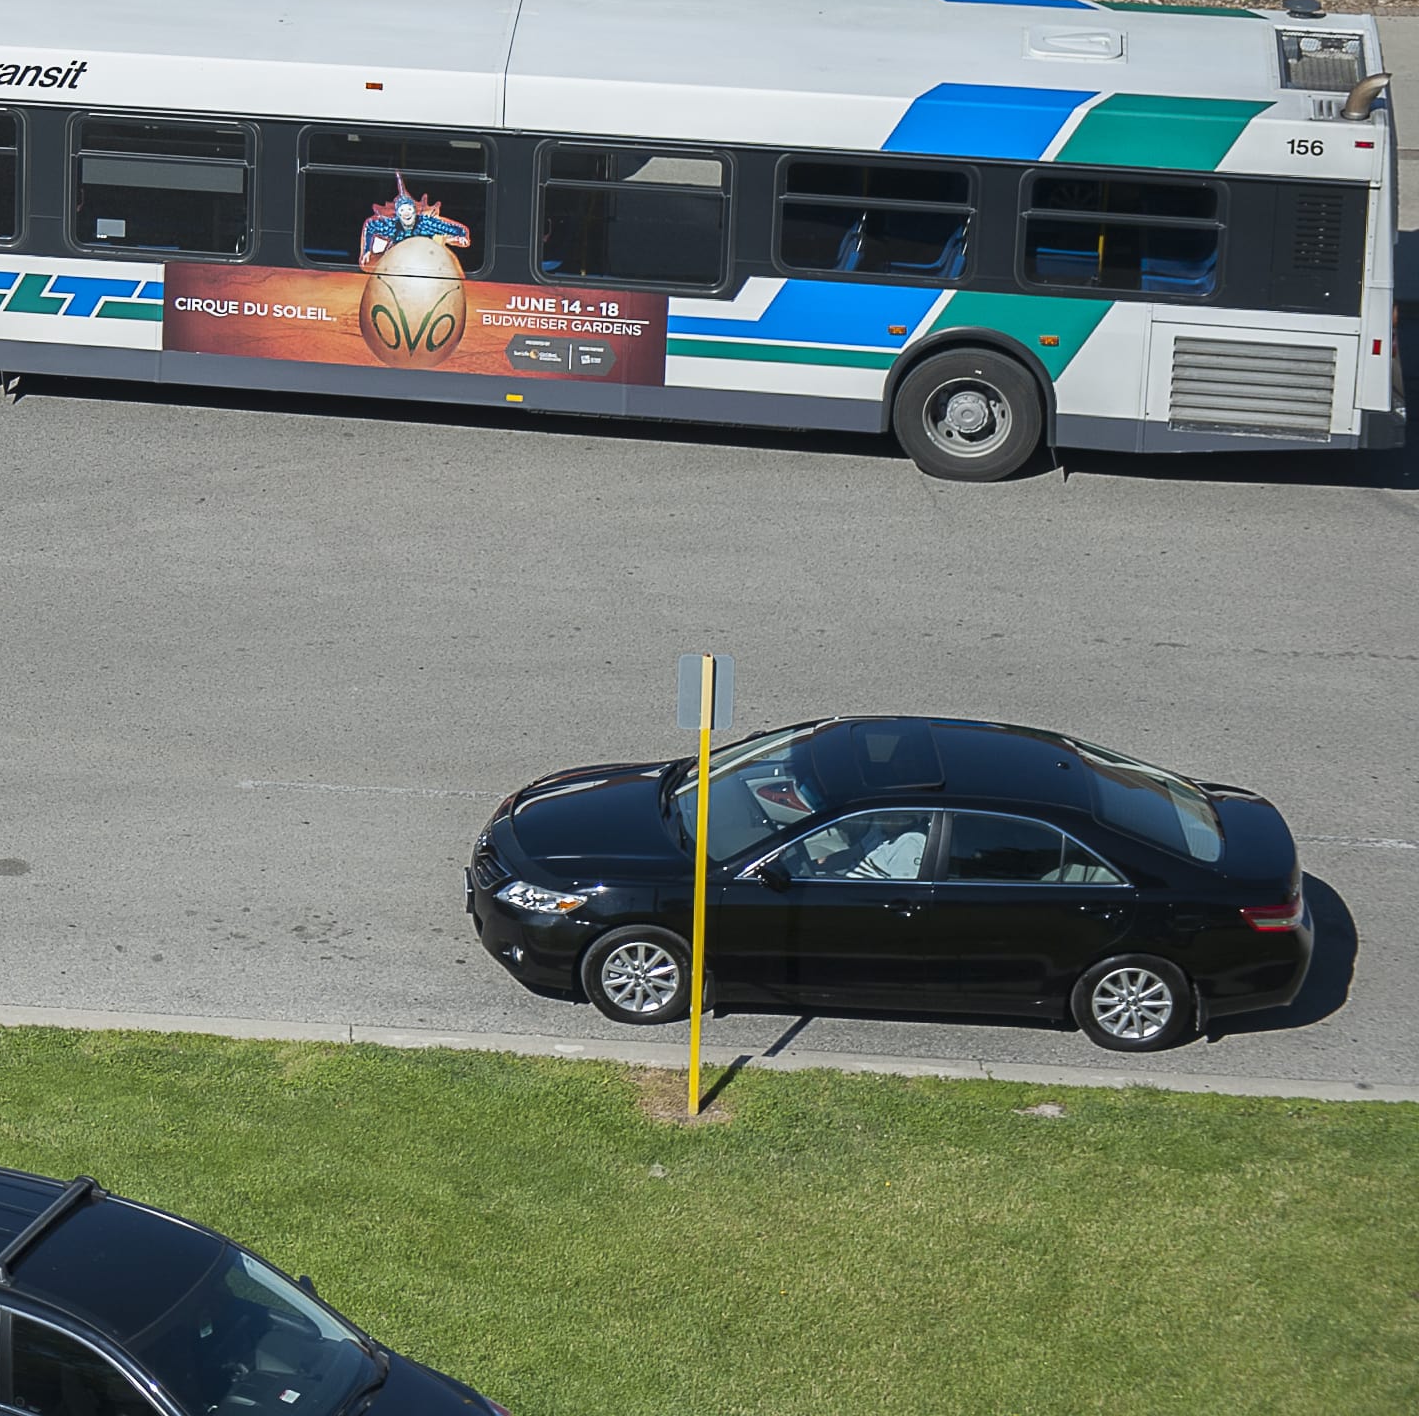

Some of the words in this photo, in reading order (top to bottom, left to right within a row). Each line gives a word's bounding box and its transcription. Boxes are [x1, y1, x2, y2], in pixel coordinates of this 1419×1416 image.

[1286, 138, 1324, 156] 156
[175, 297, 239, 317] CIRQUE
[243, 302, 269, 316] DU
[506, 296, 557, 313] JUNE
[561, 299, 582, 314] 14
[599, 302, 620, 317] 18
[482, 314, 568, 331] BUDWEISER
[571, 320, 643, 336] GARDENS
